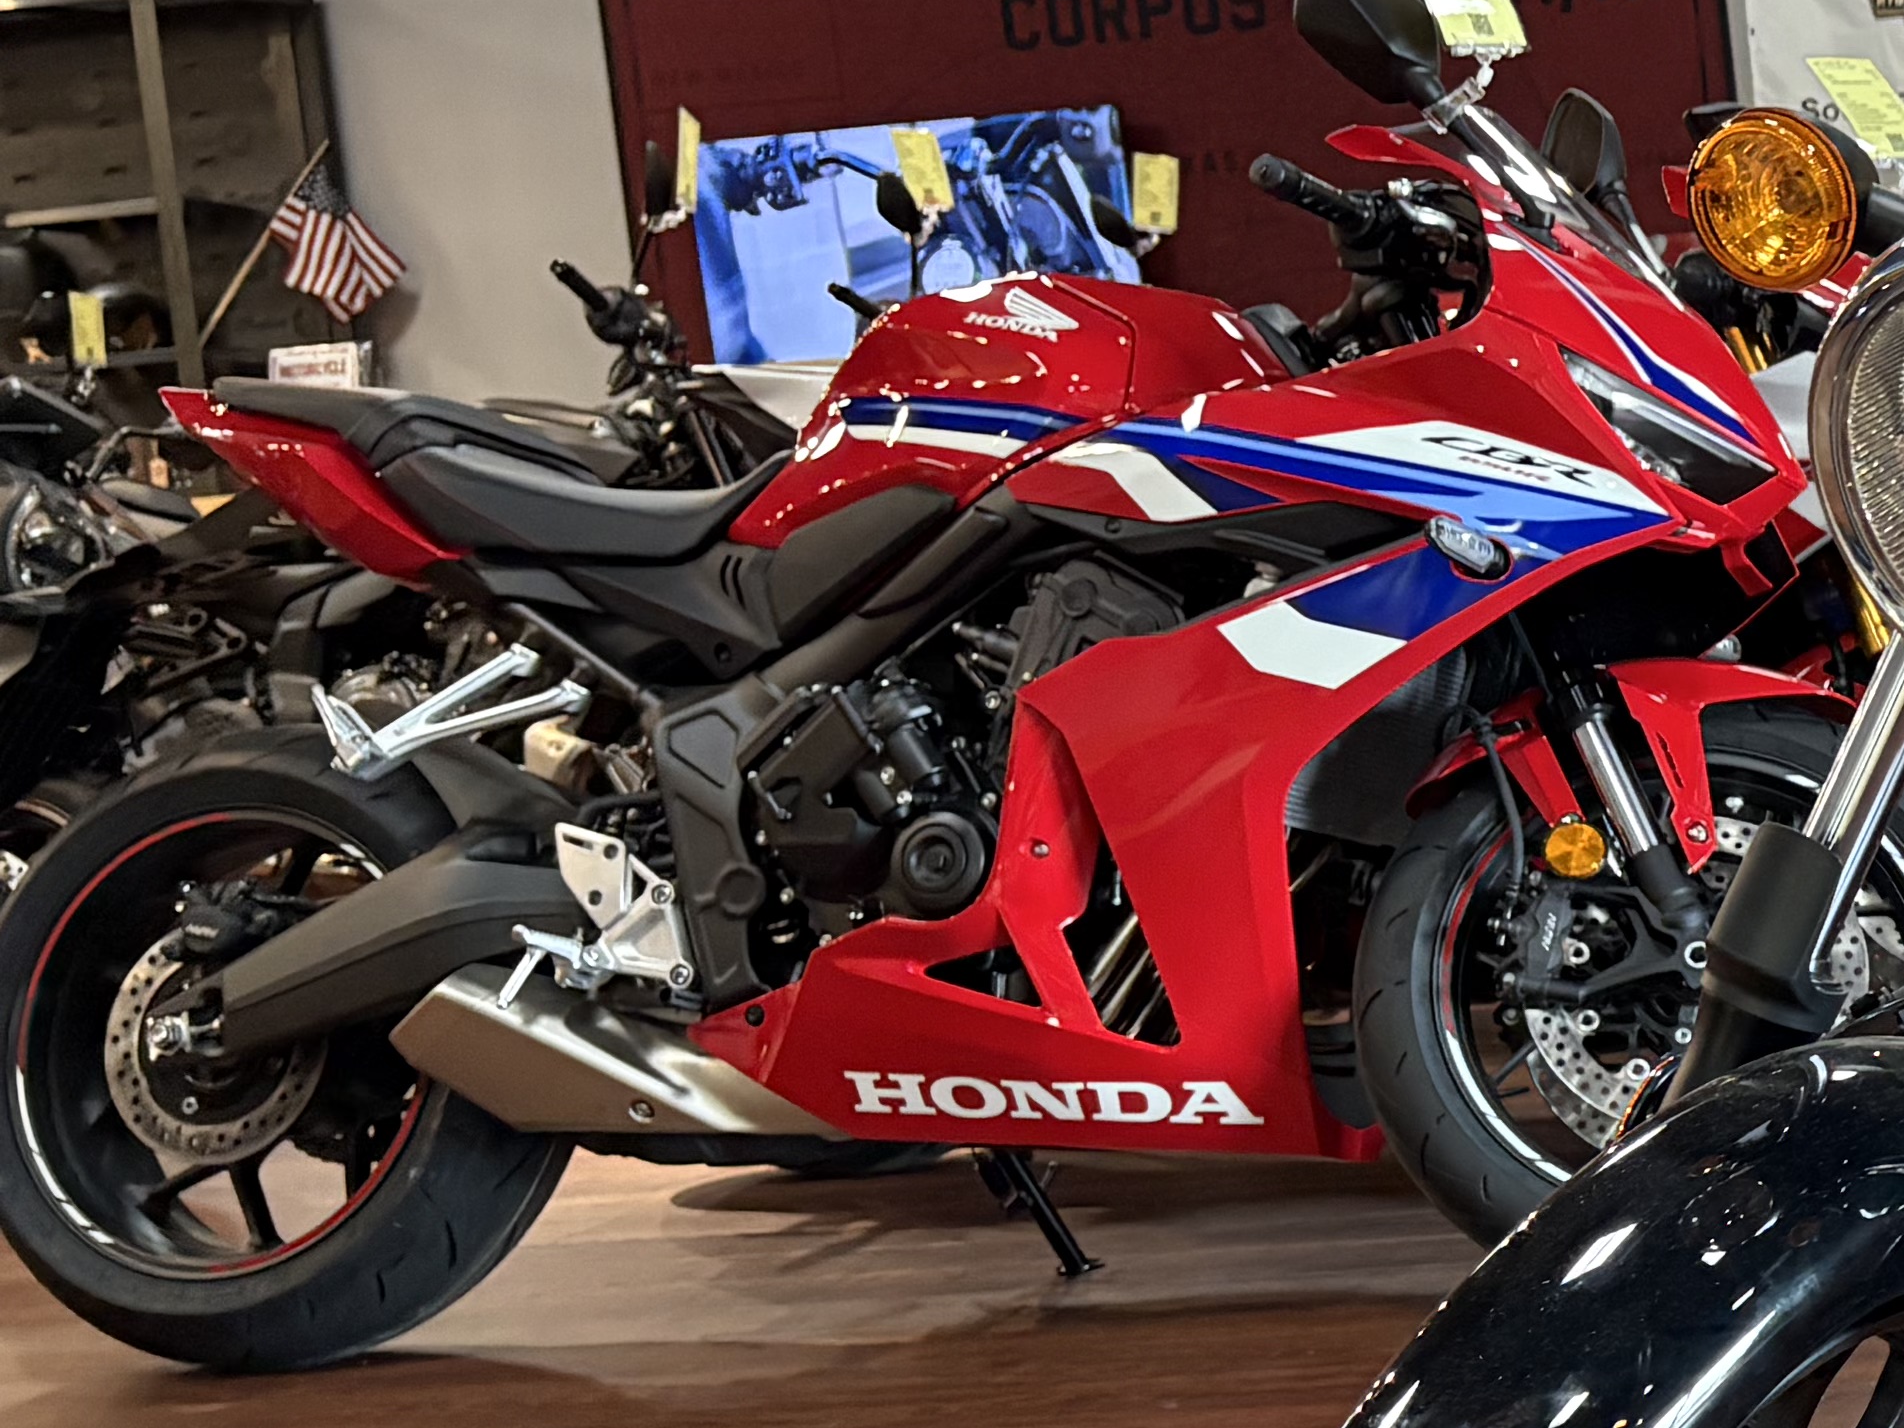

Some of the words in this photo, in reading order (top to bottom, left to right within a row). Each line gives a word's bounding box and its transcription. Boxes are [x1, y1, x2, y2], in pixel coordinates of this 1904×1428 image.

[963, 310, 1059, 344] HONDA
[1421, 435, 1597, 489] CBR
[843, 1069, 1265, 1126] HONDA
